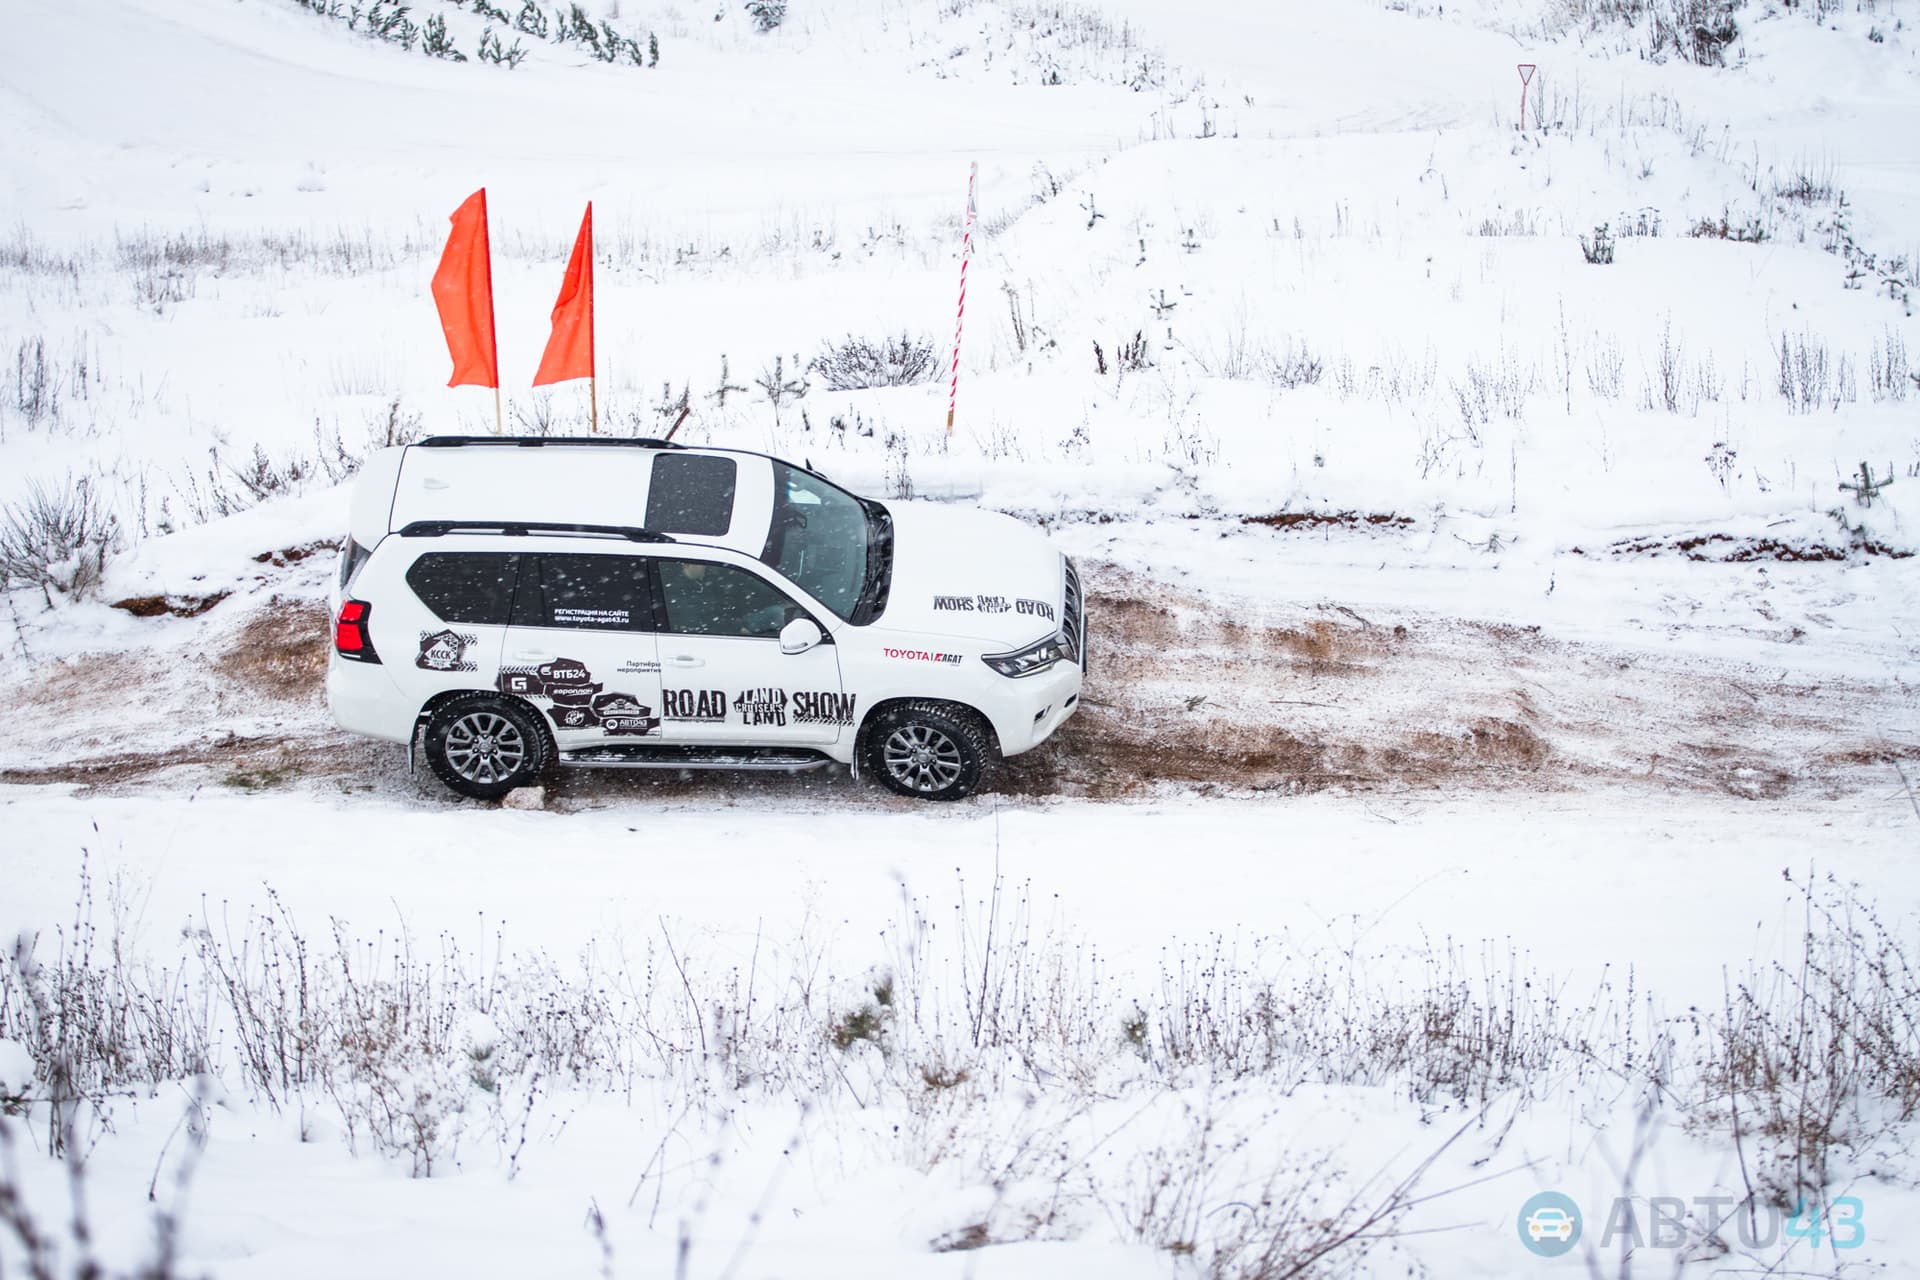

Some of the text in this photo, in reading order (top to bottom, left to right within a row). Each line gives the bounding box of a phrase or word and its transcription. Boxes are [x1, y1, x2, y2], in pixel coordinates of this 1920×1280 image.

[933, 597, 974, 611] SHOW
[554, 608, 598, 617] РЕГИСТРАЦИЯ
[608, 609, 630, 618] САЙТЕ
[1015, 600, 1055, 622] ROAD
[554, 615, 630, 624] www.toyota-agat43.ru
[430, 649, 451, 660] КССК
[884, 648, 930, 661] TOYOTA
[626, 660, 661, 668] Партнёры
[553, 668, 586, 679] ВТБ24
[744, 687, 781, 704] LAND
[662, 689, 857, 721] ROAD SHOW
[743, 711, 786, 727] LAND
